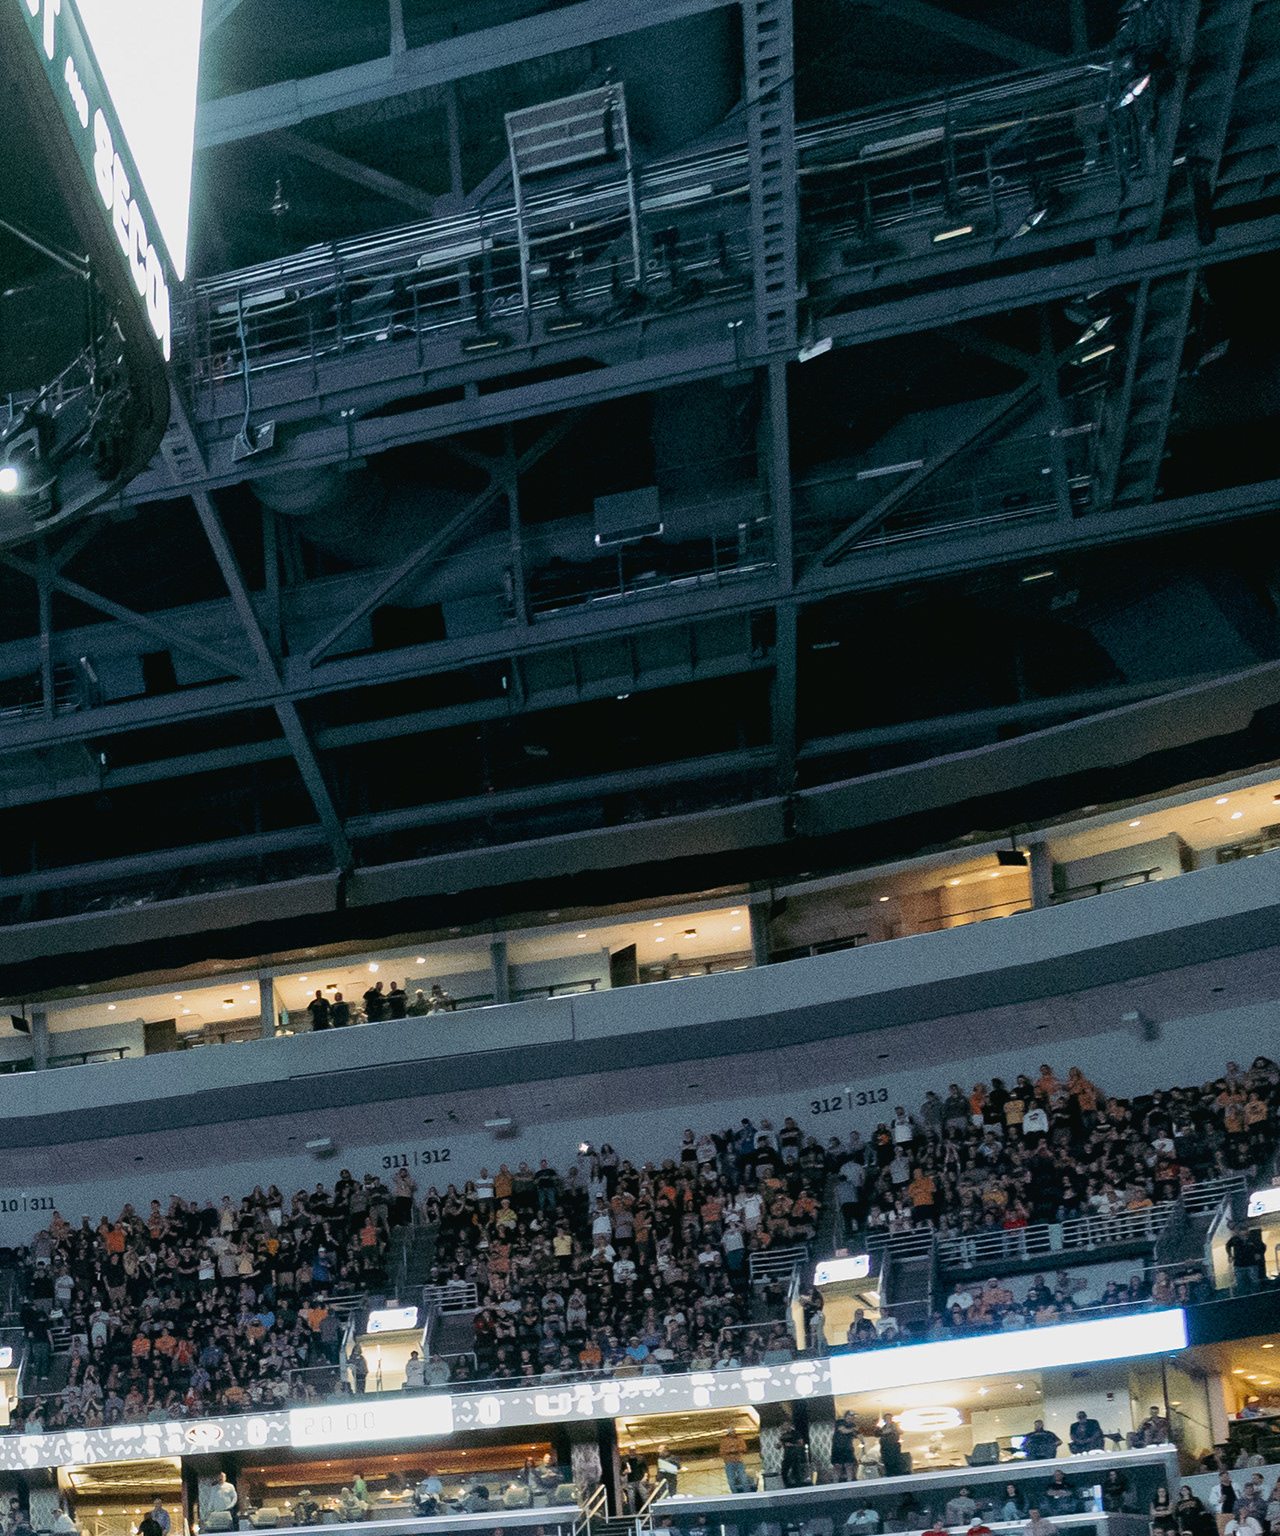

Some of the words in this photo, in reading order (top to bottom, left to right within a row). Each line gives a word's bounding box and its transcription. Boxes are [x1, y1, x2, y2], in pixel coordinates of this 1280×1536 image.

[810, 1096, 843, 1115] 312
[856, 1087, 889, 1106] 313
[381, 1153, 410, 1169] 311
[421, 1148, 451, 1164] 312
[30, 1197, 56, 1211] 311
